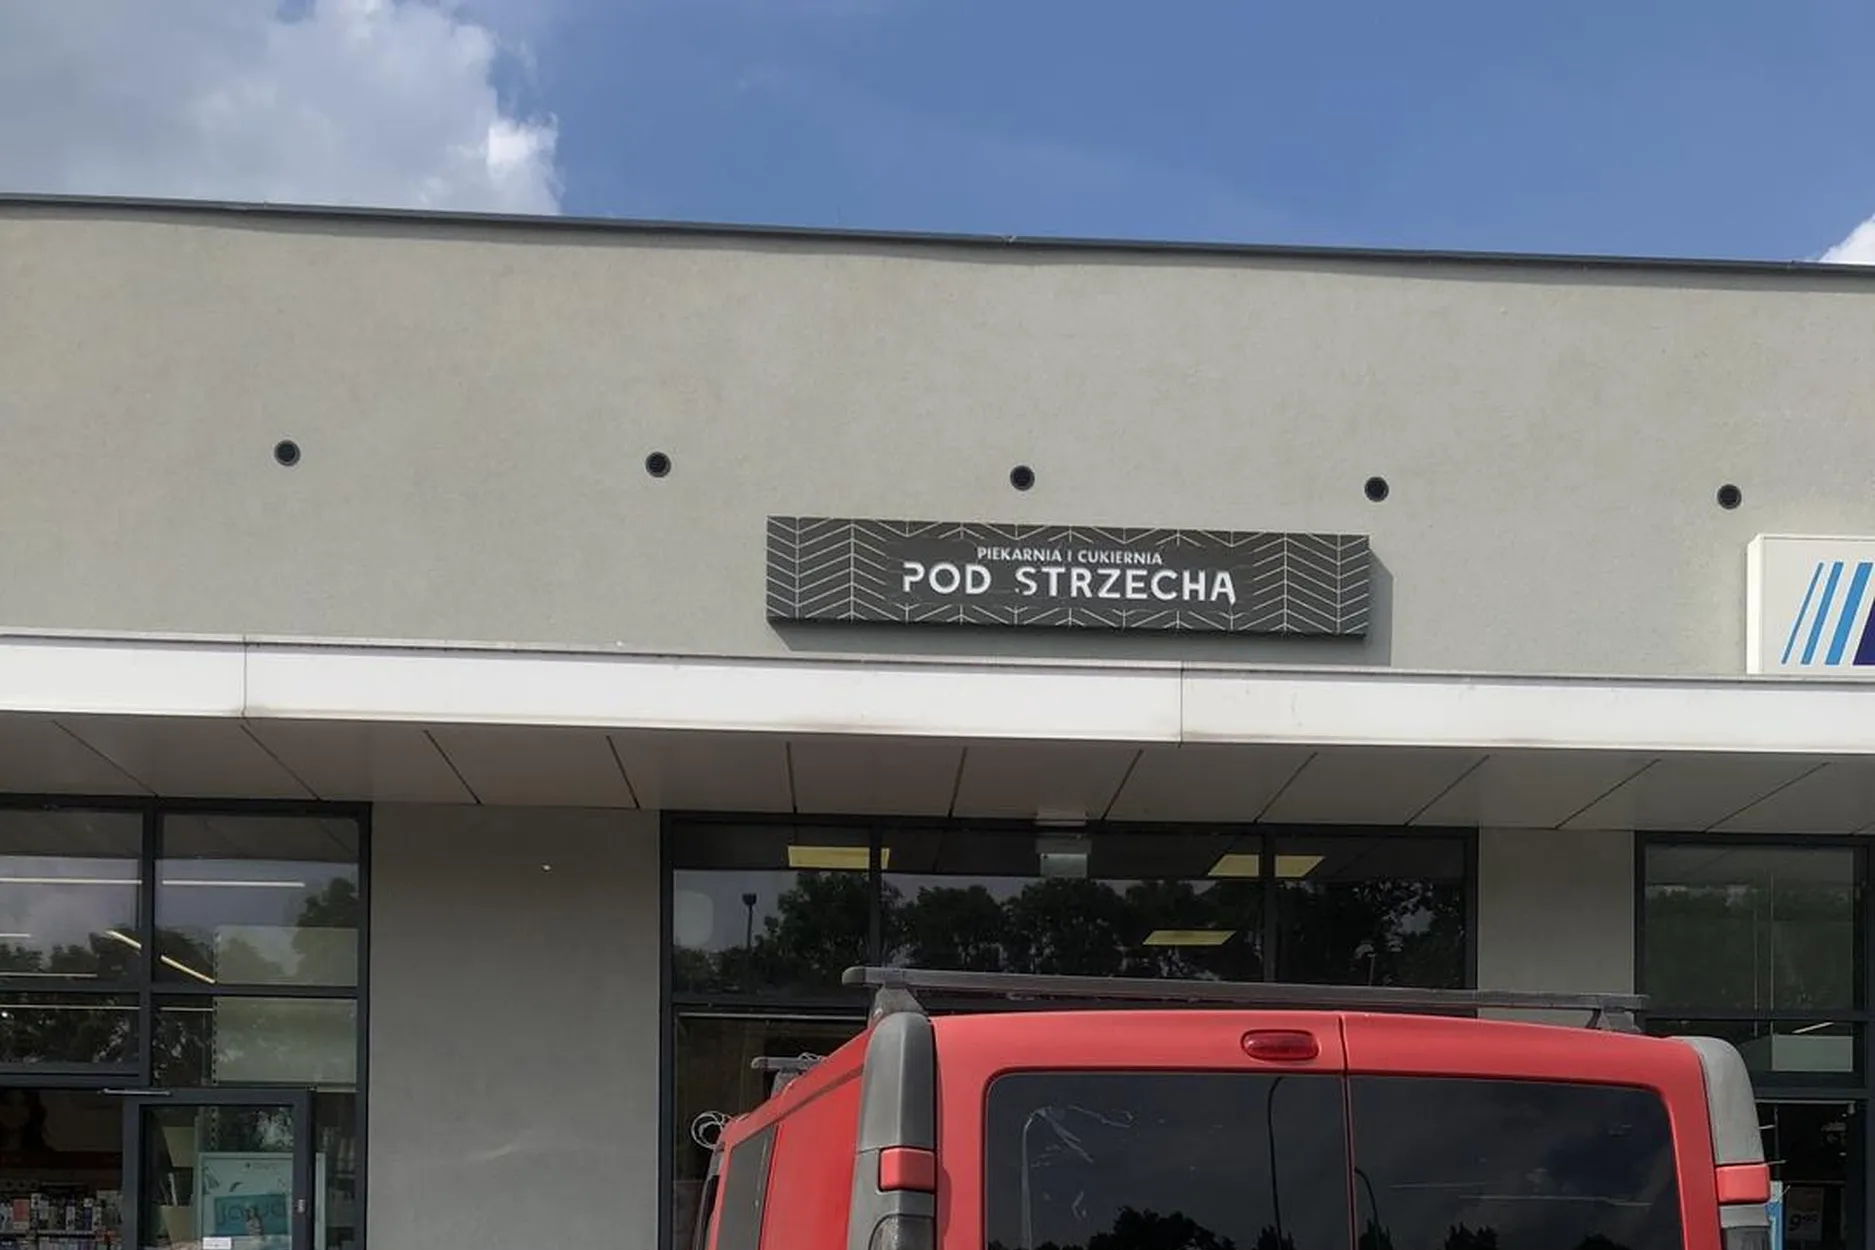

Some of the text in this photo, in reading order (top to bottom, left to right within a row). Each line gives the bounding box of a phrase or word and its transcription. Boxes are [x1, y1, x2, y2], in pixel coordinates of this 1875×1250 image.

[977, 546, 1062, 562] PIEKARNIA
[1077, 550, 1162, 565] CUKIERNIA
[902, 562, 992, 594] POD
